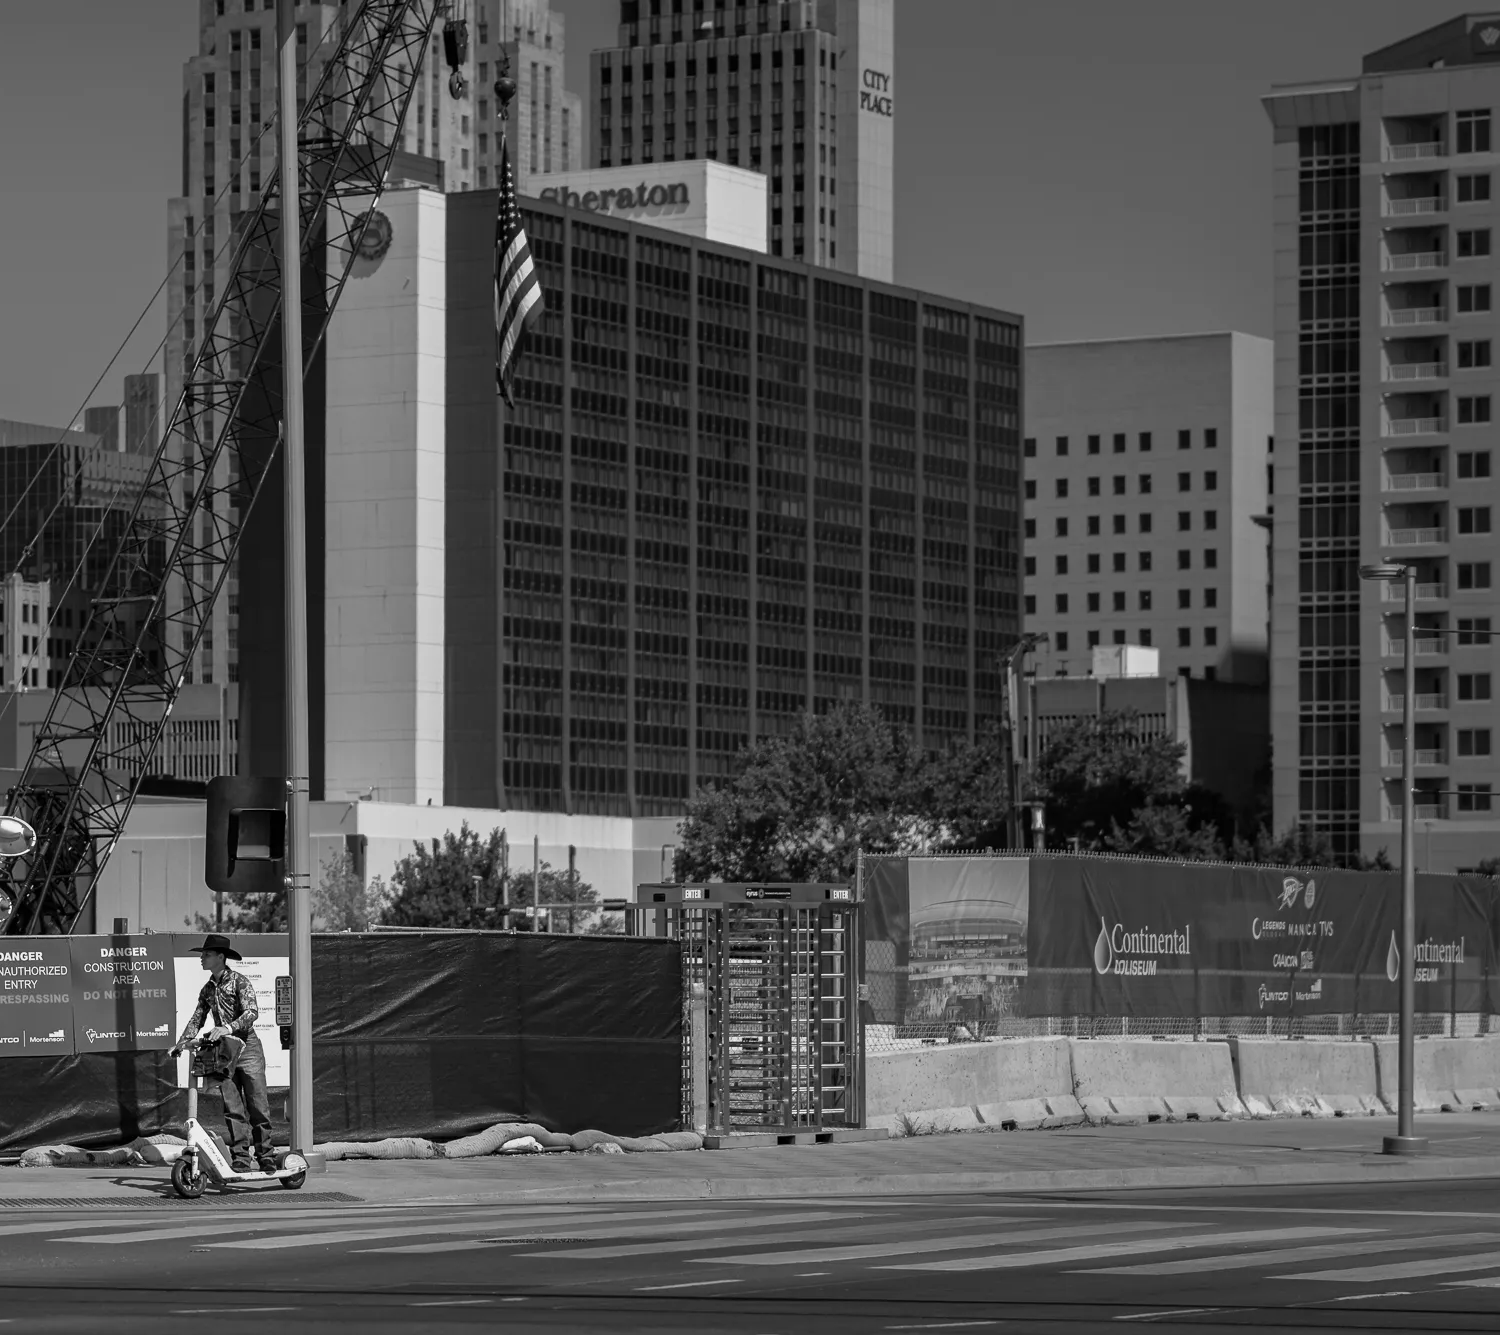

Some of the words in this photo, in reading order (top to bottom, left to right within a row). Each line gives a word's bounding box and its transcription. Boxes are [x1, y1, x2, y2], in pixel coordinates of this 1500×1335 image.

[863, 68, 890, 92] CITY
[860, 90, 892, 117] PLACE
[684, 889, 702, 899] ENTER
[833, 890, 849, 900] ENTER
[1262, 921, 1286, 930] LEGENDS
[1319, 921, 1334, 936] TVS
[1112, 923, 1190, 955] Continental
[100, 947, 148, 957] DANGER
[1414, 935, 1465, 963] ntinental
[83, 961, 164, 973] CONSTRUCTION
[4, 980, 38, 989] ENTRY
[112, 975, 141, 985] AREA
[83, 991, 100, 1000] DO
[104, 990, 128, 999] NOT
[132, 989, 167, 998] ENTER
